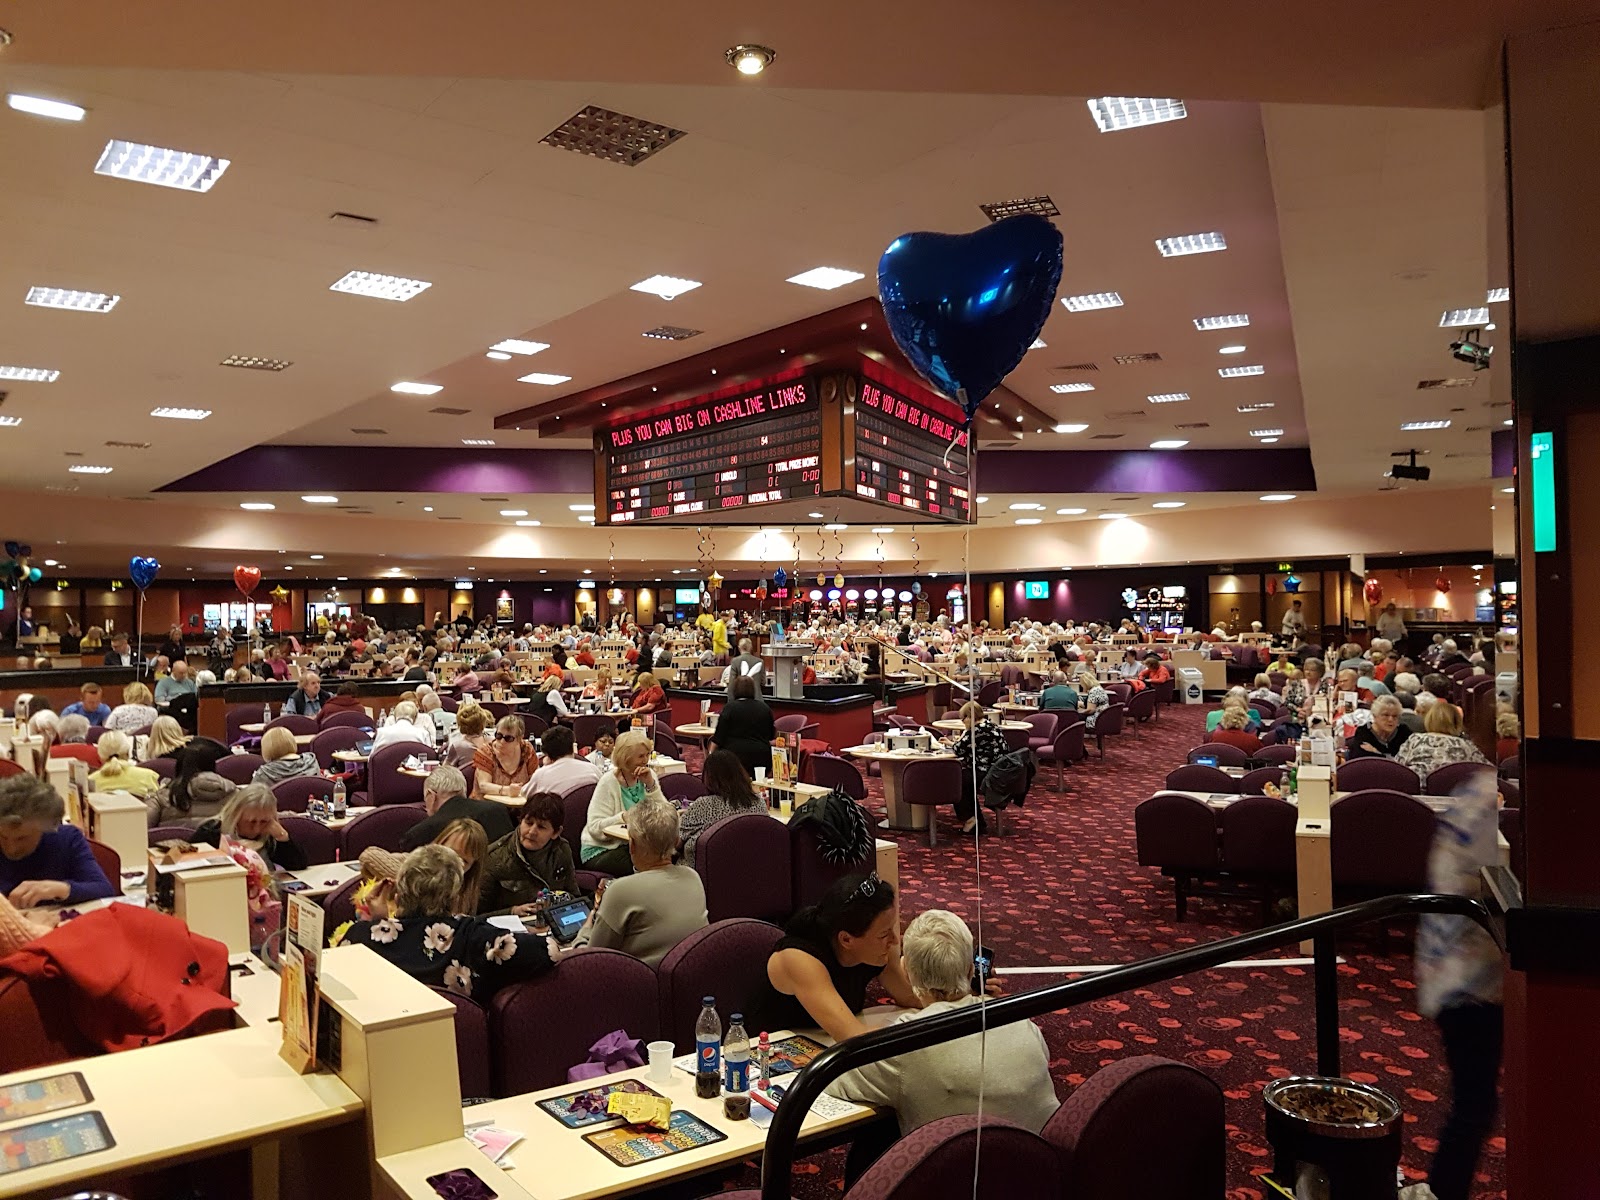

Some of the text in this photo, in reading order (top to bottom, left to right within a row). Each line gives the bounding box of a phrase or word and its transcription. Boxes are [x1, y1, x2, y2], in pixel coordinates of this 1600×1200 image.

[611, 384, 806, 448] PLUS YOU CAN BIG ON CASHLINE LINKS
[862, 384, 880, 408] PLUS
[881, 393, 895, 415] YOU
[895, 400, 909, 420] CAN
[907, 406, 920, 426] BIG
[920, 412, 930, 430] ON
[760, 435, 768, 446] 54
